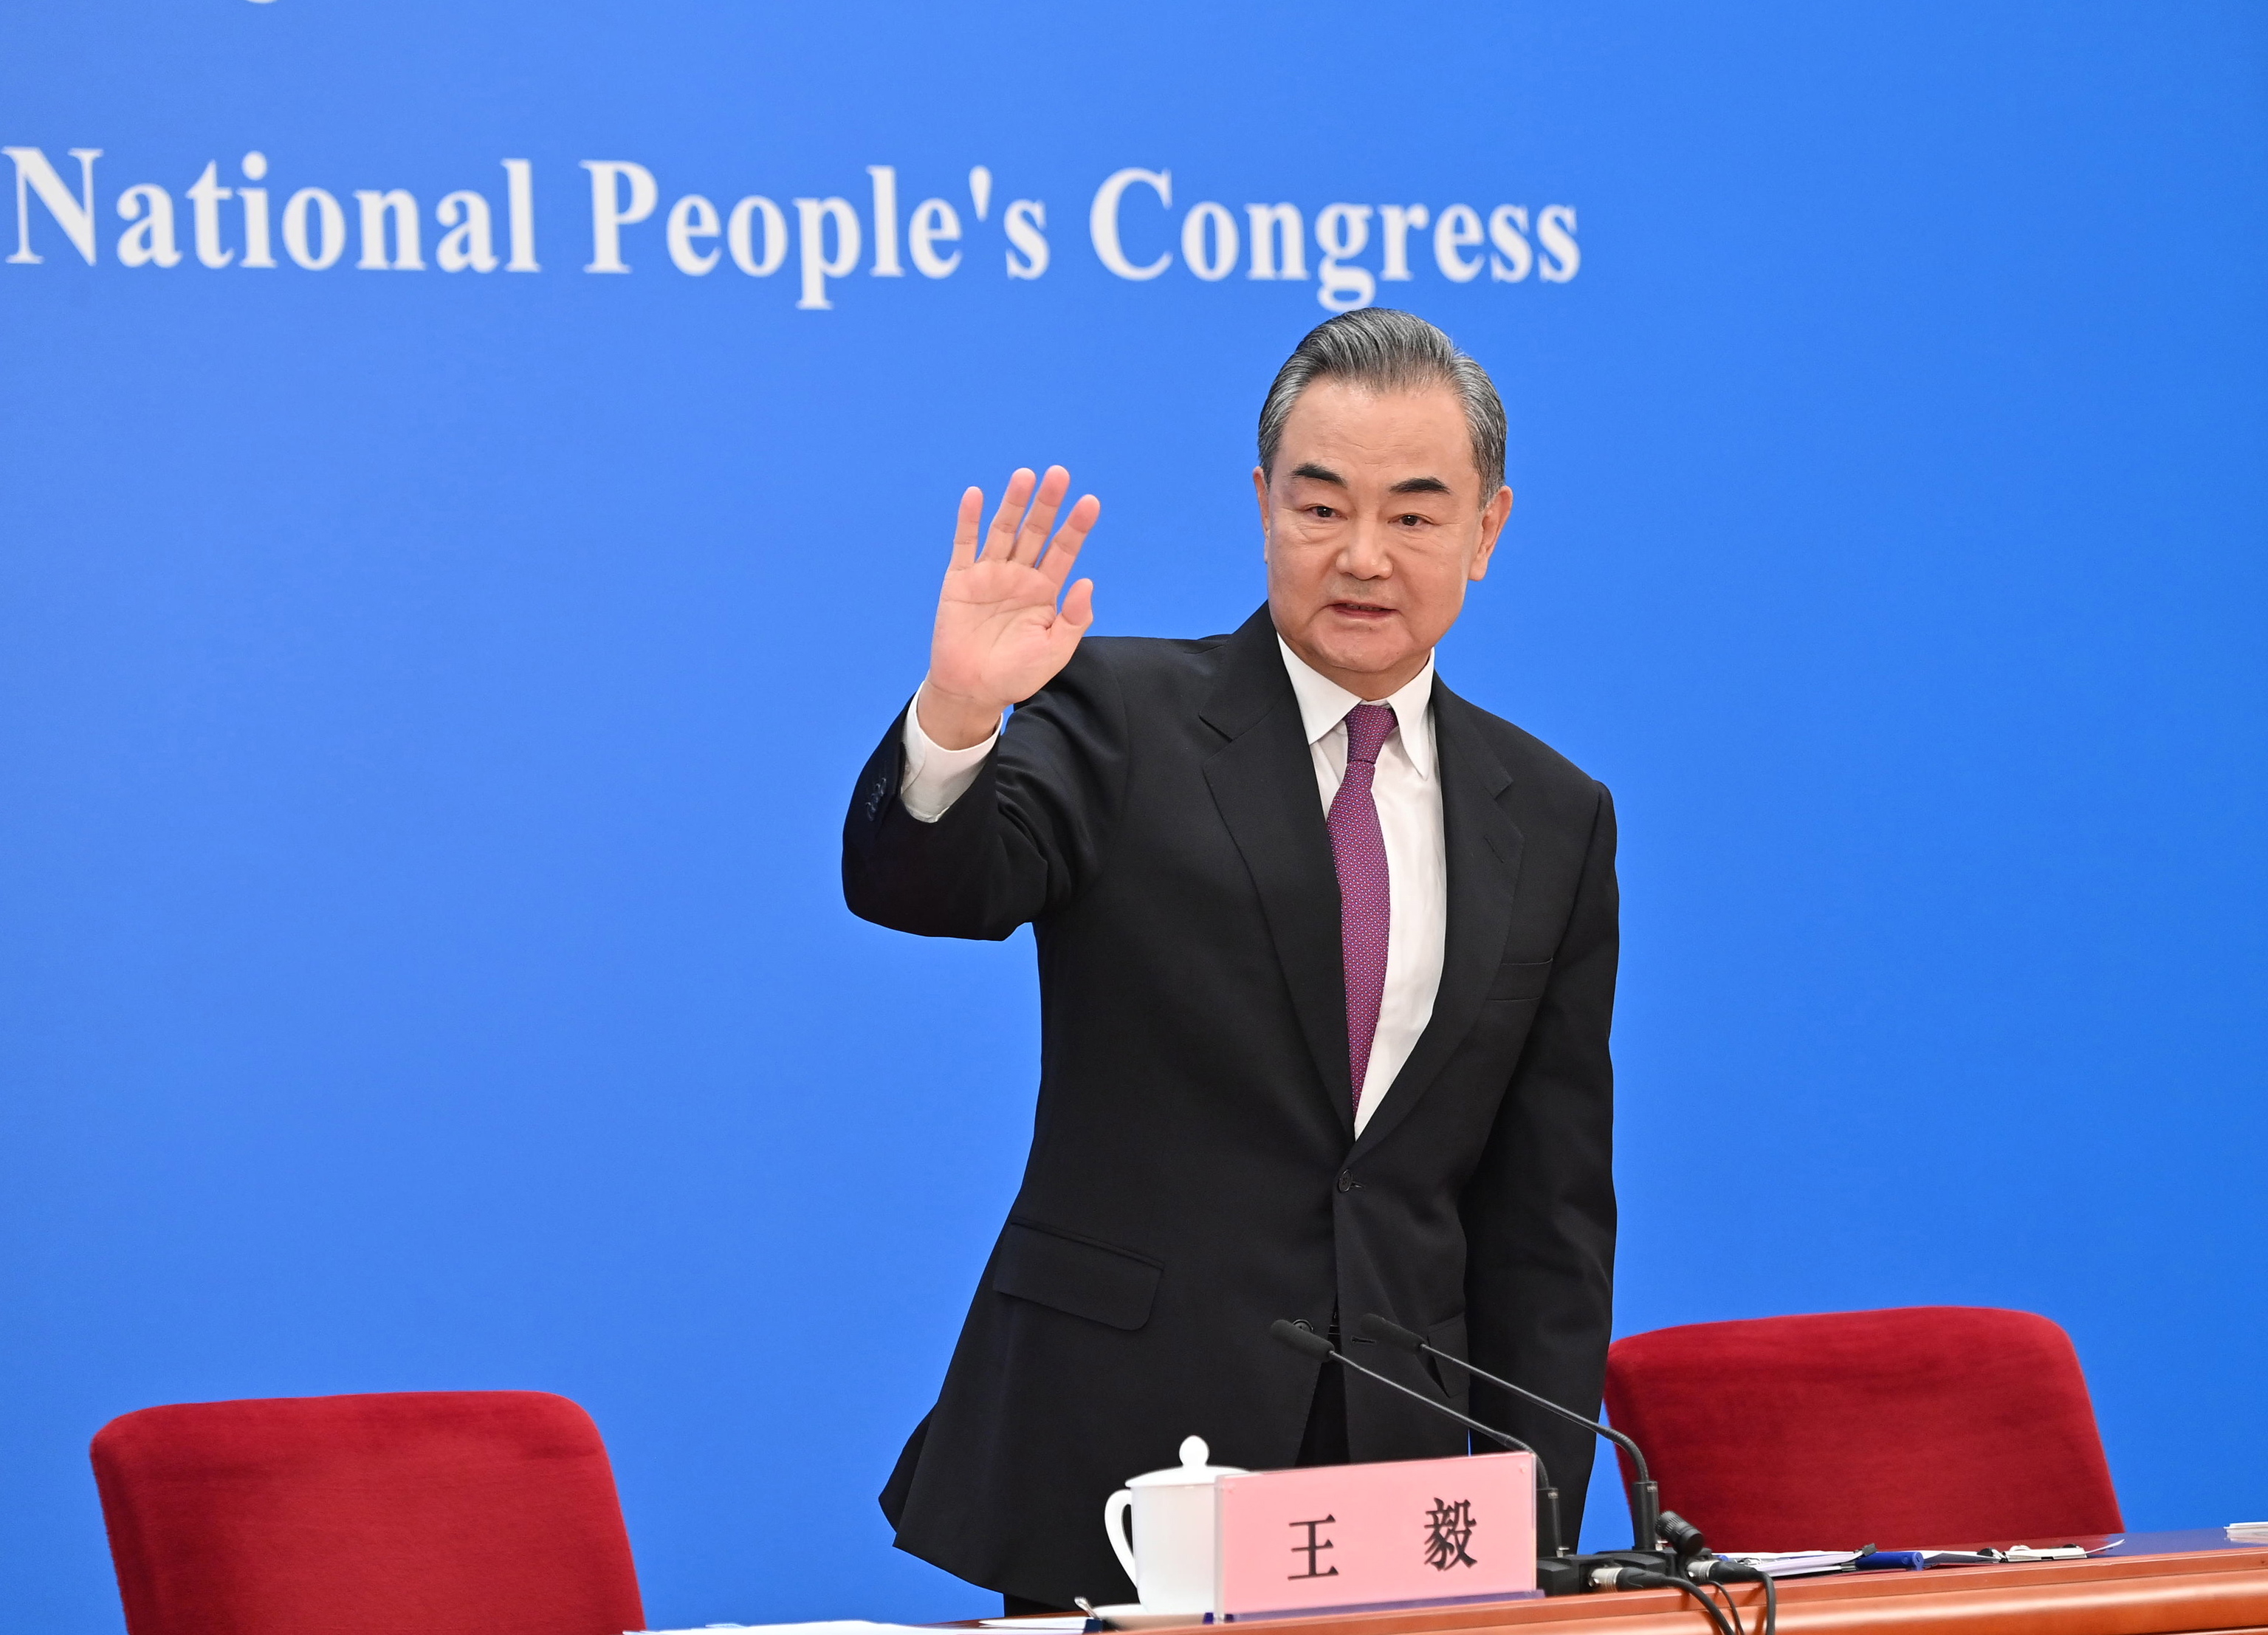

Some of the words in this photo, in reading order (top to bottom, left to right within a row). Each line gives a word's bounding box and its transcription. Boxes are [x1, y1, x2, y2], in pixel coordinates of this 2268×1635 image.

[2, 146, 540, 273] National
[582, 160, 1049, 310] People's
[1089, 167, 1581, 312] Congress
